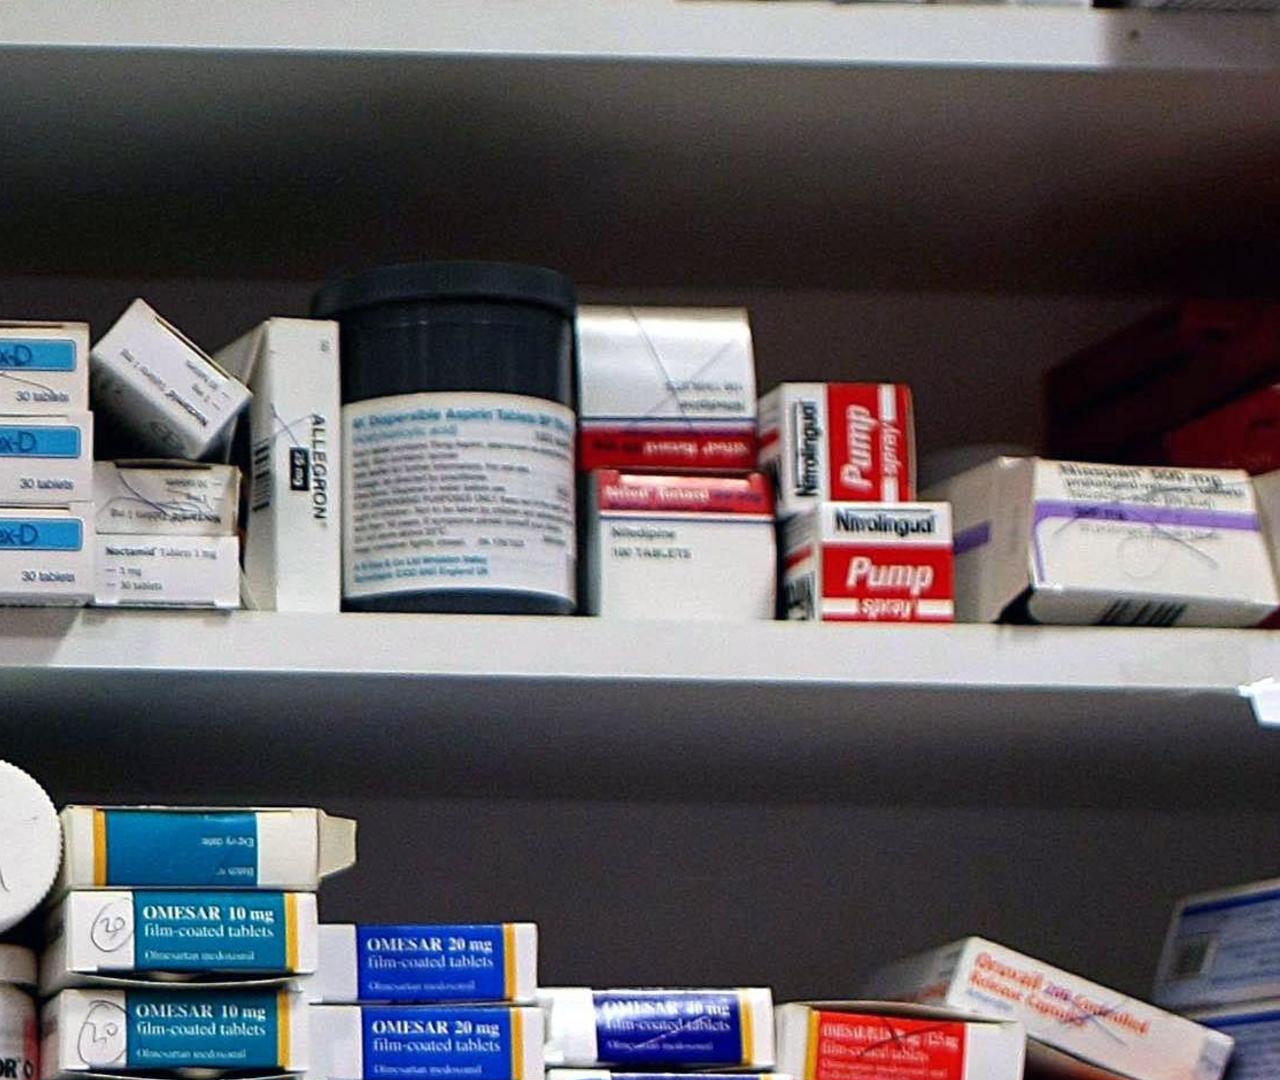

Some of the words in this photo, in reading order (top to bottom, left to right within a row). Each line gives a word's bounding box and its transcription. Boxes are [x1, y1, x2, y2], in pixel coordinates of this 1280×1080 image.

[312, 413, 325, 521] ALLEGRON
[21, 479, 35, 490] 30
[39, 479, 74, 490] tablets
[835, 512, 935, 536] Nitrolingual
[846, 558, 933, 593] Pump
[143, 906, 221, 921] OMESAR
[230, 906, 245, 920] 10
[248, 911, 274, 925] mg
[143, 924, 224, 938] film-coated
[229, 924, 274, 938] tablets
[368, 938, 442, 952] OMESAR
[448, 938, 465, 951] 20
[468, 942, 493, 955] mg
